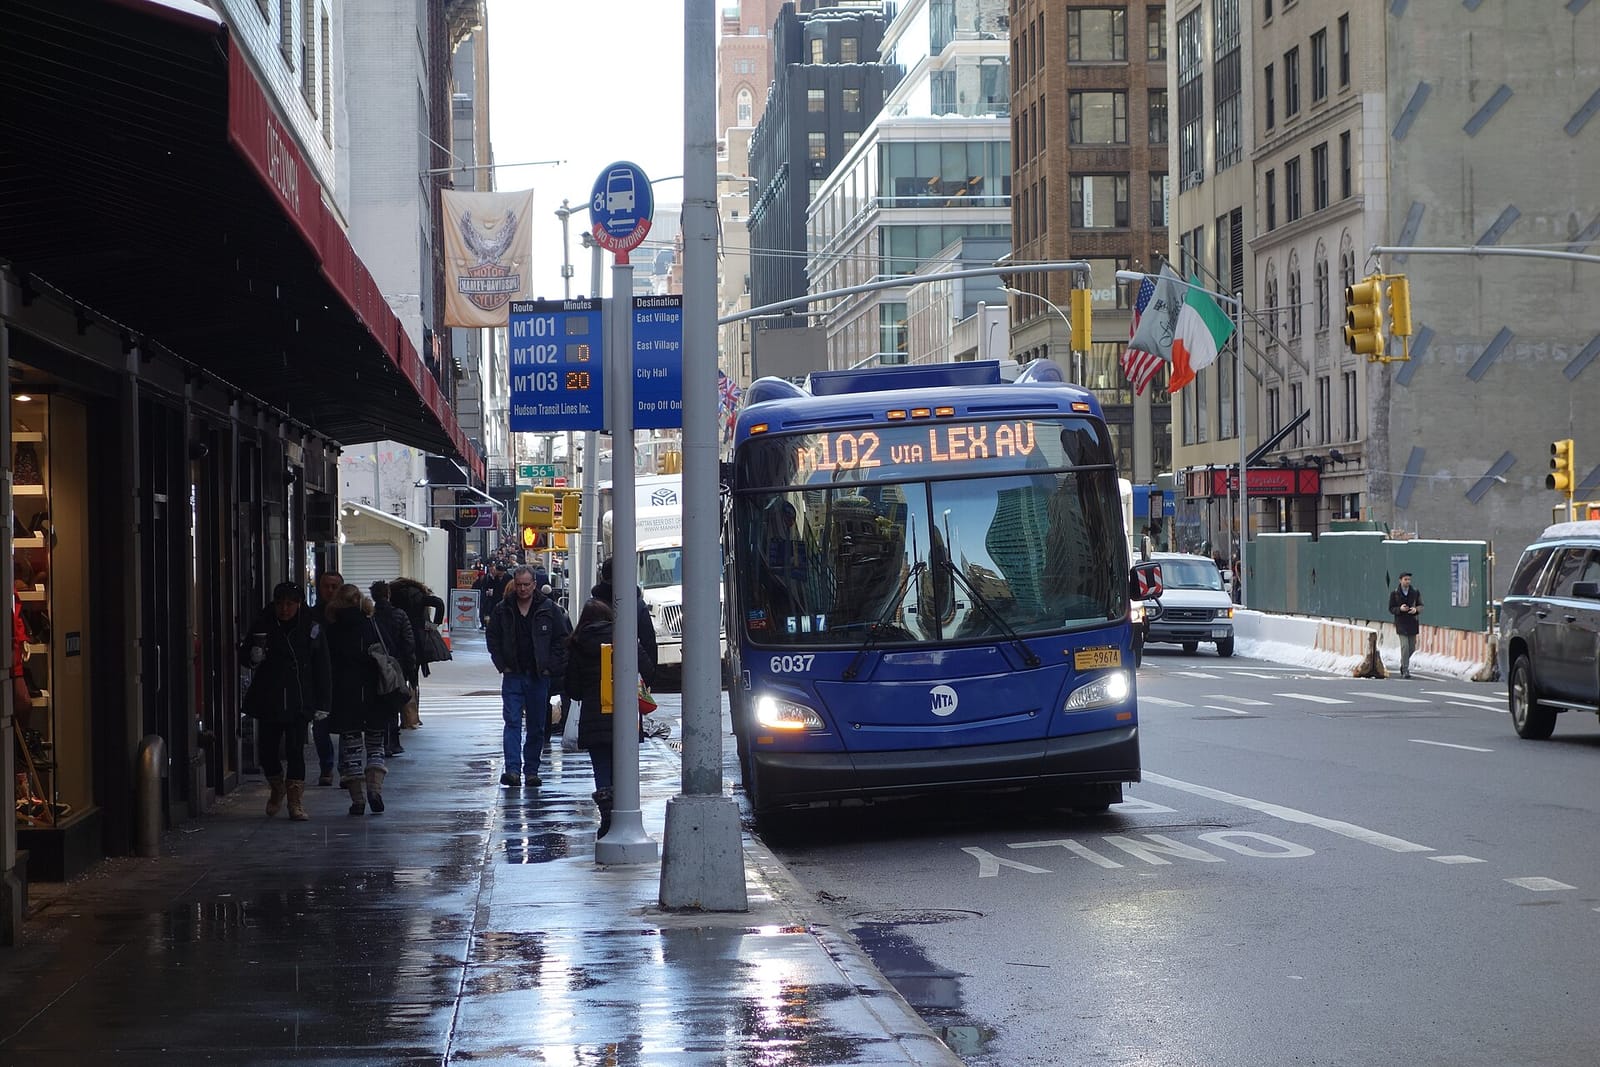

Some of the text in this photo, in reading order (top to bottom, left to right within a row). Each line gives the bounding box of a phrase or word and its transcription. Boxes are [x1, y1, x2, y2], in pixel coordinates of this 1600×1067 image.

[597, 225, 646, 248] NO STANDING
[472, 265, 506, 277] MOTOR
[461, 278, 518, 291] HARLEY-DAVIDSON
[474, 293, 505, 306] CYCLES
[564, 300, 592, 310] Minutes
[636, 297, 679, 307] Destination
[513, 303, 534, 312] Route
[637, 312, 680, 324] East Village
[514, 316, 555, 338] M101
[636, 340, 679, 350] East Village
[514, 344, 558, 364] M102
[578, 344, 590, 361] 0
[566, 372, 590, 389] 20
[637, 368, 668, 380] City Hall
[514, 372, 558, 392] M103
[514, 402, 591, 416] Hudson Transit Lines Inc.
[638, 400, 683, 412] Drop Off Onl
[797, 422, 1036, 473] M102 VIA LEX AV
[520, 466, 528, 477] E
[532, 466, 547, 476] 56
[786, 616, 796, 632] 5
[816, 614, 826, 632] 7
[770, 654, 815, 674] 6037
[930, 693, 954, 710] MTA
[960, 831, 1316, 878] ONLY
